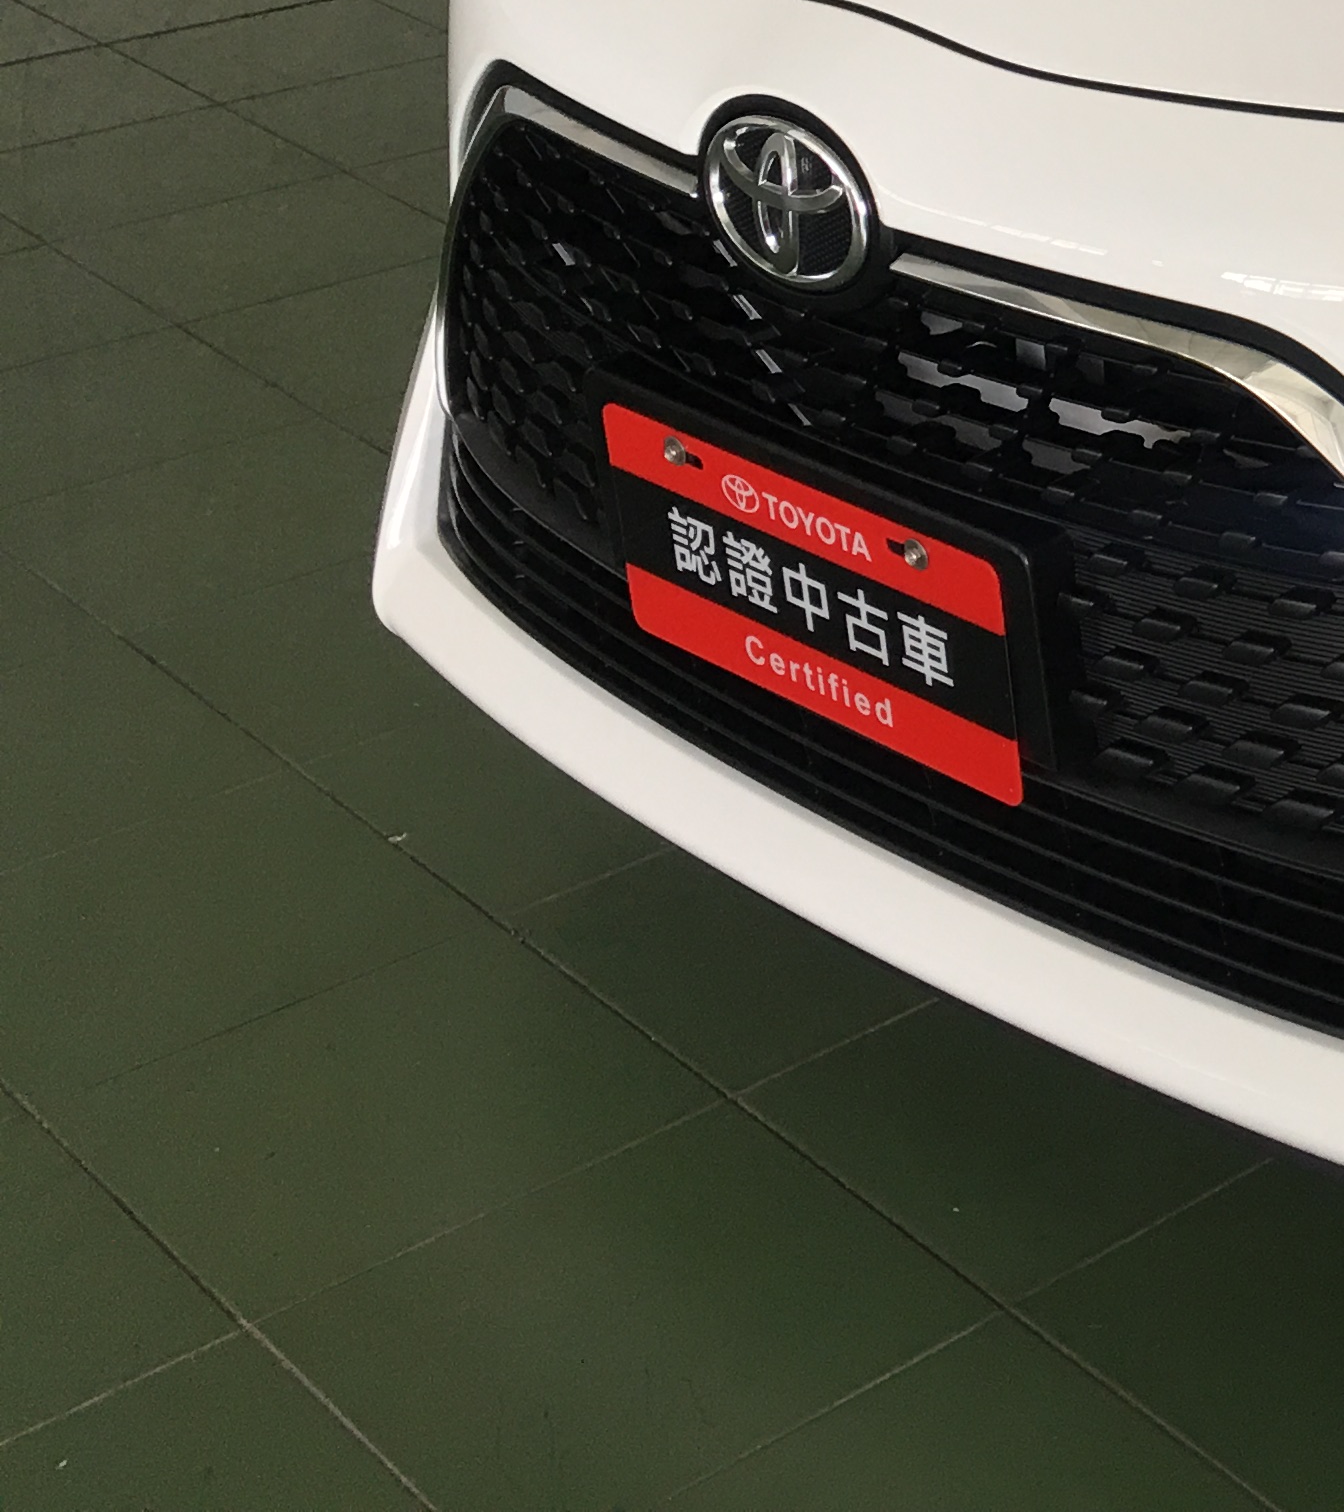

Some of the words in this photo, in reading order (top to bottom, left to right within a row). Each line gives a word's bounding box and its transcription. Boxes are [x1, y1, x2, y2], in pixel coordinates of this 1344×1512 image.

[762, 491, 872, 562] TOYOTA
[667, 506, 955, 687] 認證中古車
[744, 635, 894, 728] Certified
